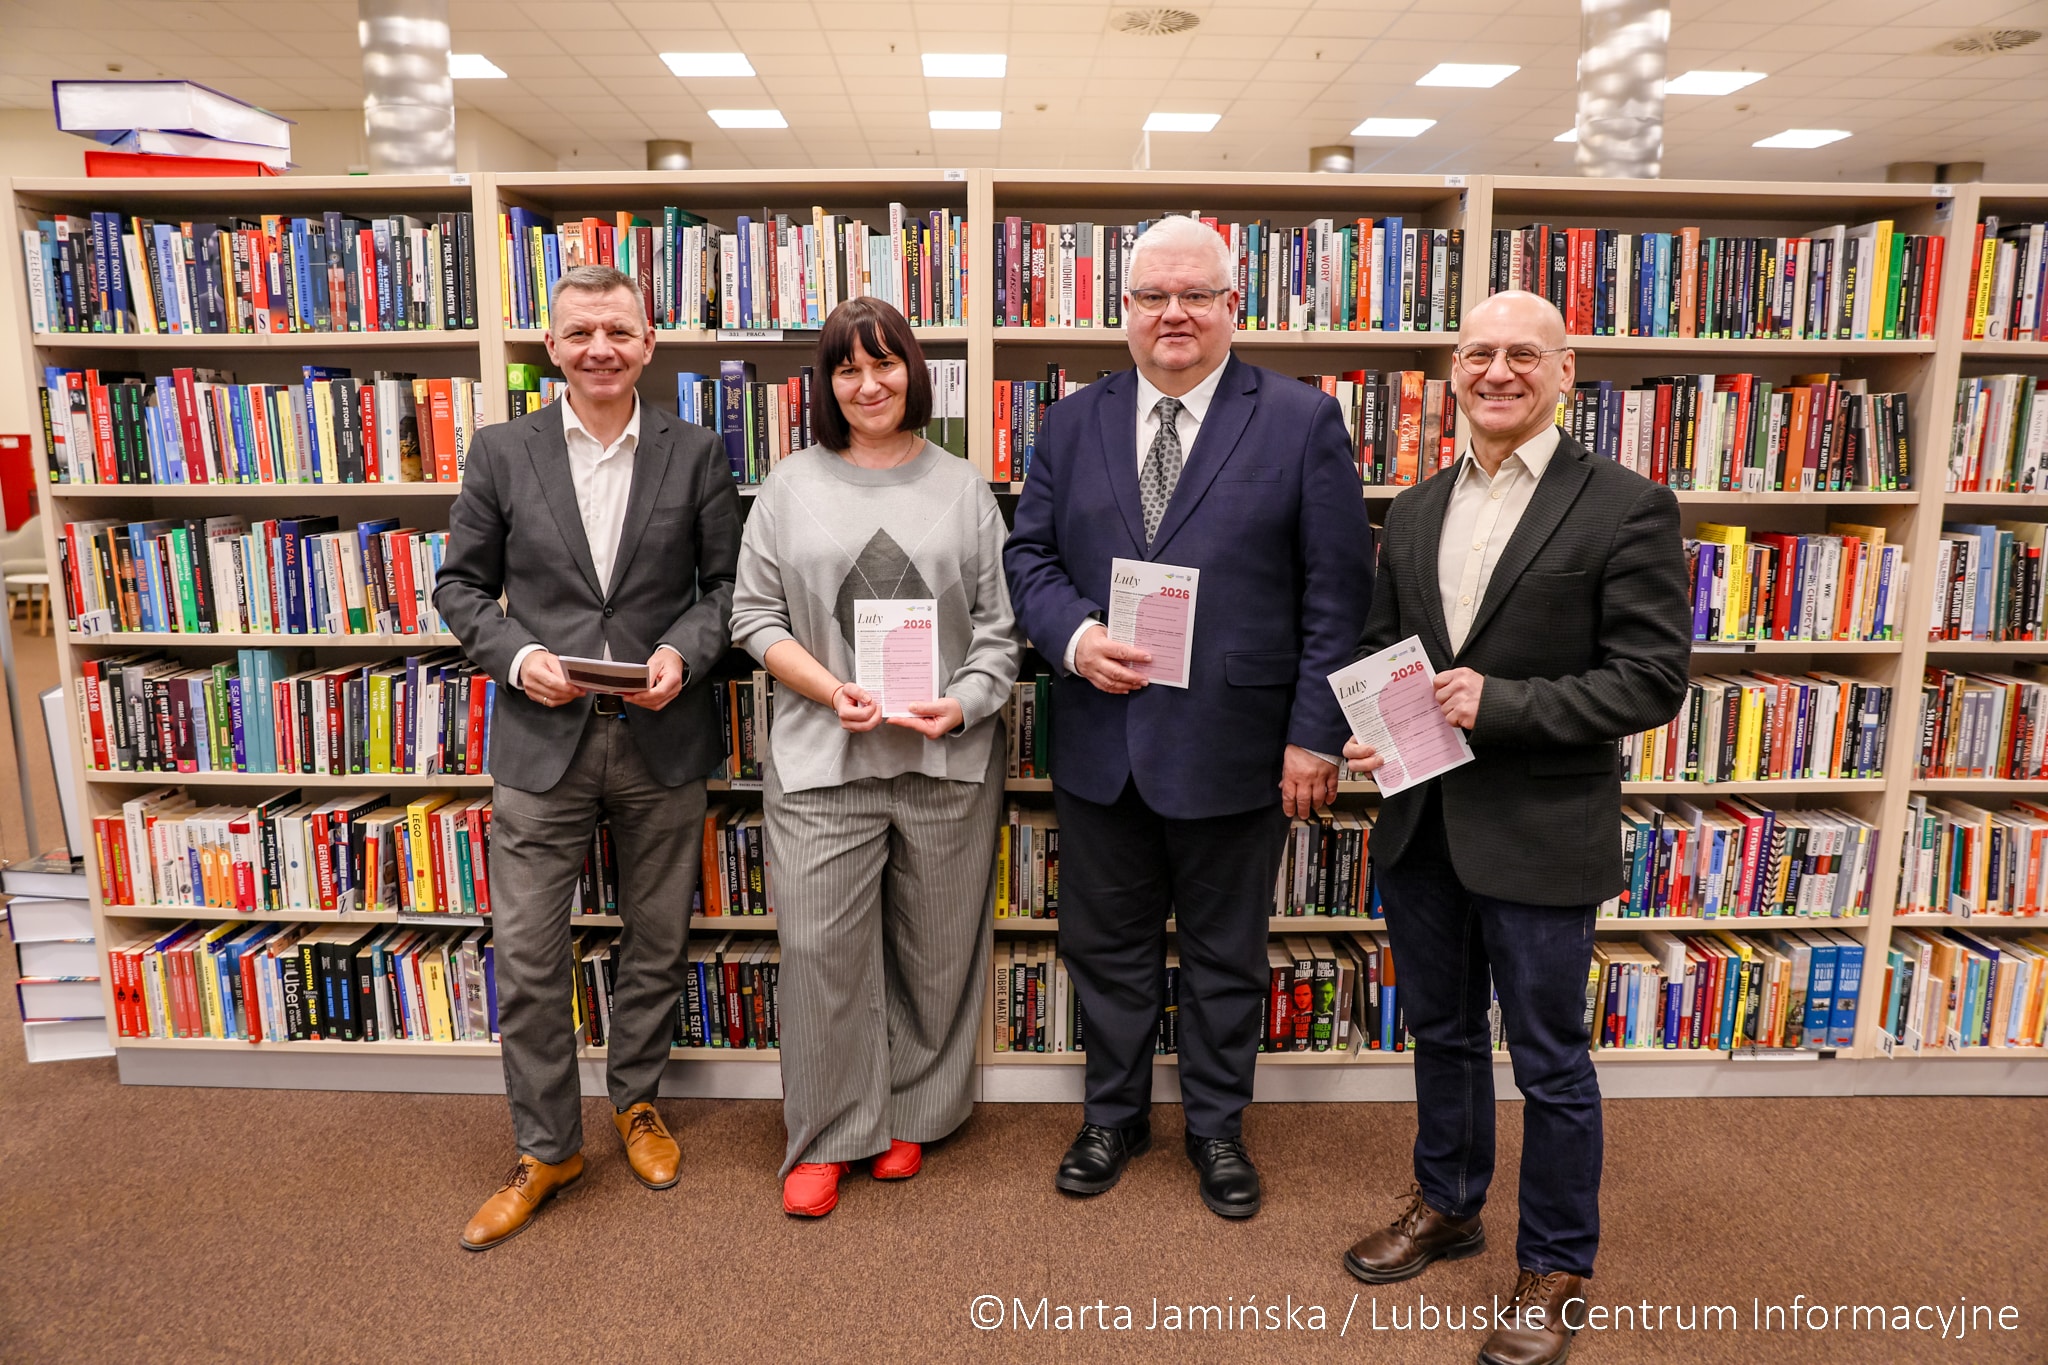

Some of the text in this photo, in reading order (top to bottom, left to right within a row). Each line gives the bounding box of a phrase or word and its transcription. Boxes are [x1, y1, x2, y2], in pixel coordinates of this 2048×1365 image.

[93, 220, 108, 292] ALFABET ROKITY
[108, 221, 122, 292] ALFABET ROKITY
[1281, 248, 1289, 287] SHADOWMAN
[1320, 254, 1330, 282] WORY
[1511, 237, 1521, 281] GOMORRA
[1766, 257, 1776, 278] MASA
[1785, 261, 1796, 277] 447
[382, 265, 391, 309] NA KREMLU
[379, 290, 387, 316] ZIMA
[259, 314, 266, 330] S
[1989, 320, 1999, 337] C
[340, 385, 351, 429] AGENT STORM
[364, 392, 372, 413] CHINY
[1027, 388, 1035, 411] WALKA
[1675, 386, 1683, 417] THORWALD
[1688, 386, 1697, 417] THORWALD
[1027, 412, 1035, 432] PRZEZ
[1364, 391, 1375, 440] BEZLITOSNE
[1641, 398, 1653, 452] OSZUSTKI
[1823, 423, 1832, 432] TO
[998, 428, 1006, 462] McMafia
[1400, 413, 1410, 452] ESCOBAR
[1409, 424, 1418, 441] PANI
[1822, 433, 1831, 447] JEST
[455, 427, 465, 471] SZCZECIN
[1898, 438, 1908, 477] MORDERCY
[1803, 473, 1814, 488] W
[284, 533, 296, 566] RAFAŁ
[235, 572, 245, 604] Tochman
[385, 559, 397, 596] MINJAN
[1114, 572, 1141, 588] Luty
[1160, 586, 1190, 600] 2026
[857, 613, 884, 626] Luty
[1803, 588, 1815, 630] CHŁOPCY
[83, 615, 100, 635] ŚT
[328, 618, 337, 634] U
[379, 618, 386, 633] V
[418, 617, 429, 634] W
[903, 619, 932, 629] 2026
[1390, 660, 1425, 683] 2026
[328, 679, 337, 708] STRACH
[1339, 679, 1367, 699] Luty
[89, 702, 100, 712] 80
[231, 685, 242, 729] SEJM WITA
[745, 717, 753, 741] TOKYO
[1796, 717, 1805, 748] SŁUCHAM
[1863, 731, 1872, 764] SUROGATKI
[427, 759, 435, 775] Z
[412, 813, 422, 838] LEGO
[1746, 827, 1761, 868] ATAKUJĄ
[317, 843, 332, 898] GERMANOFIL
[729, 856, 737, 893] OBYWATEL
[1961, 903, 1970, 919] D
[303, 948, 317, 1025] DOKTRYNA SZOKU
[467, 983, 475, 1002] Steve
[473, 983, 481, 1000] After
[997, 968, 1007, 997] DOBRE
[1015, 967, 1025, 993] PORWANY
[1693, 1011, 1702, 1037] STRACHU
[1883, 1037, 1893, 1054] H
[1947, 1033, 1958, 1052] K
